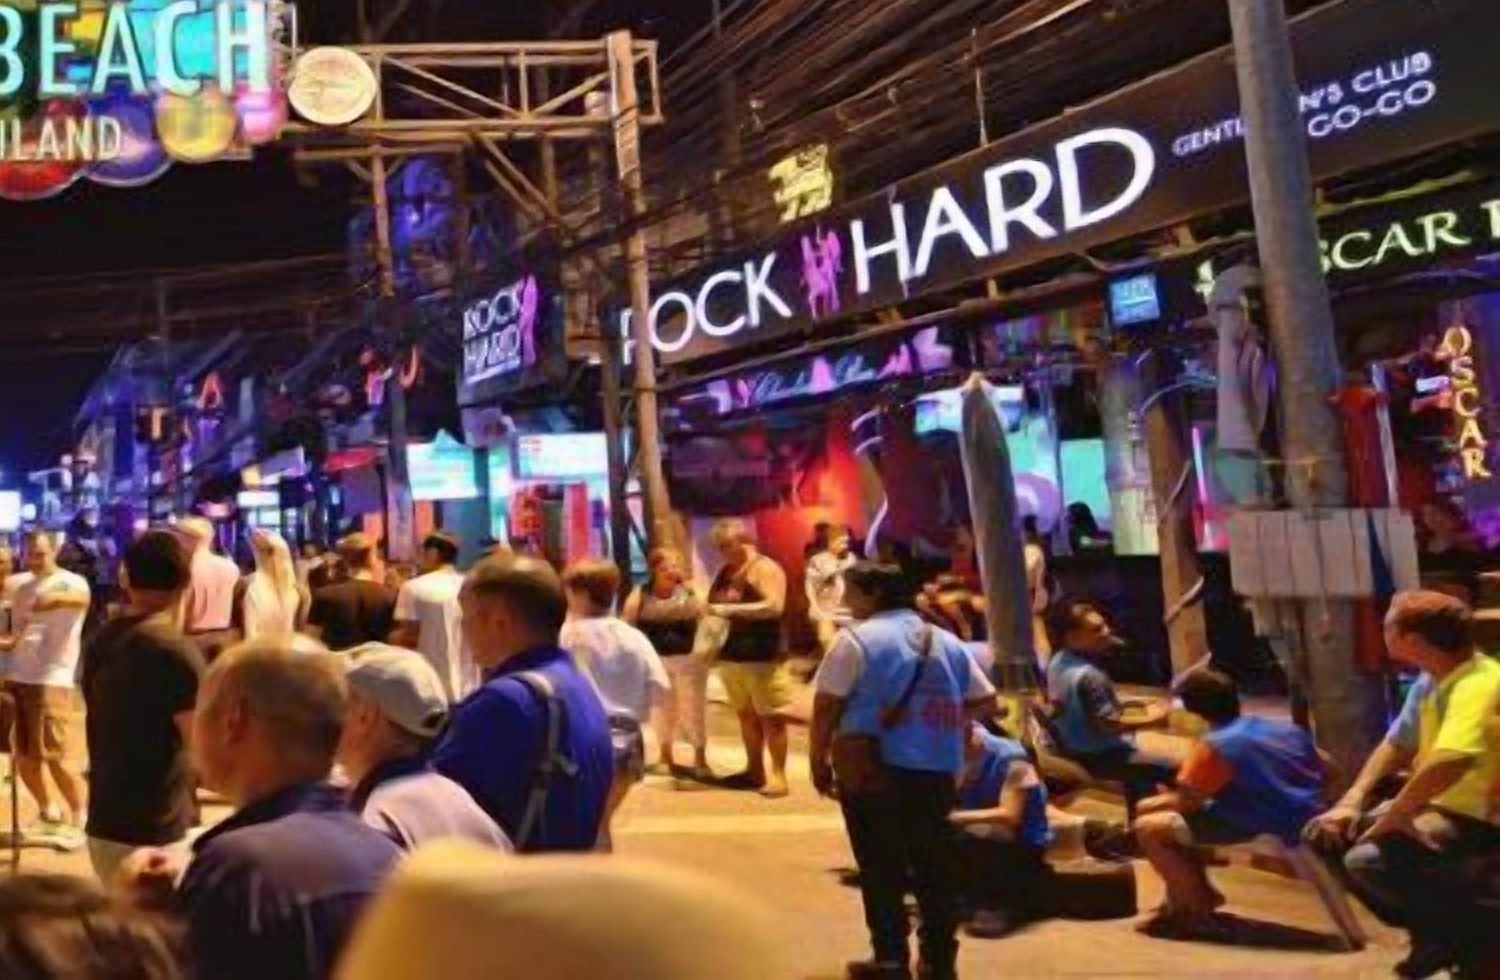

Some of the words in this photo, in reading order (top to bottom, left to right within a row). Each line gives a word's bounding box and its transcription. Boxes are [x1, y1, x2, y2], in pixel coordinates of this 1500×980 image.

[1351, 51, 1431, 93] CLUB
[1308, 80, 1437, 138] GO-GO
[850, 127, 1156, 295] HARD
[1317, 211, 1472, 274] SCAR
[1435, 324, 1493, 478] OSCAR
